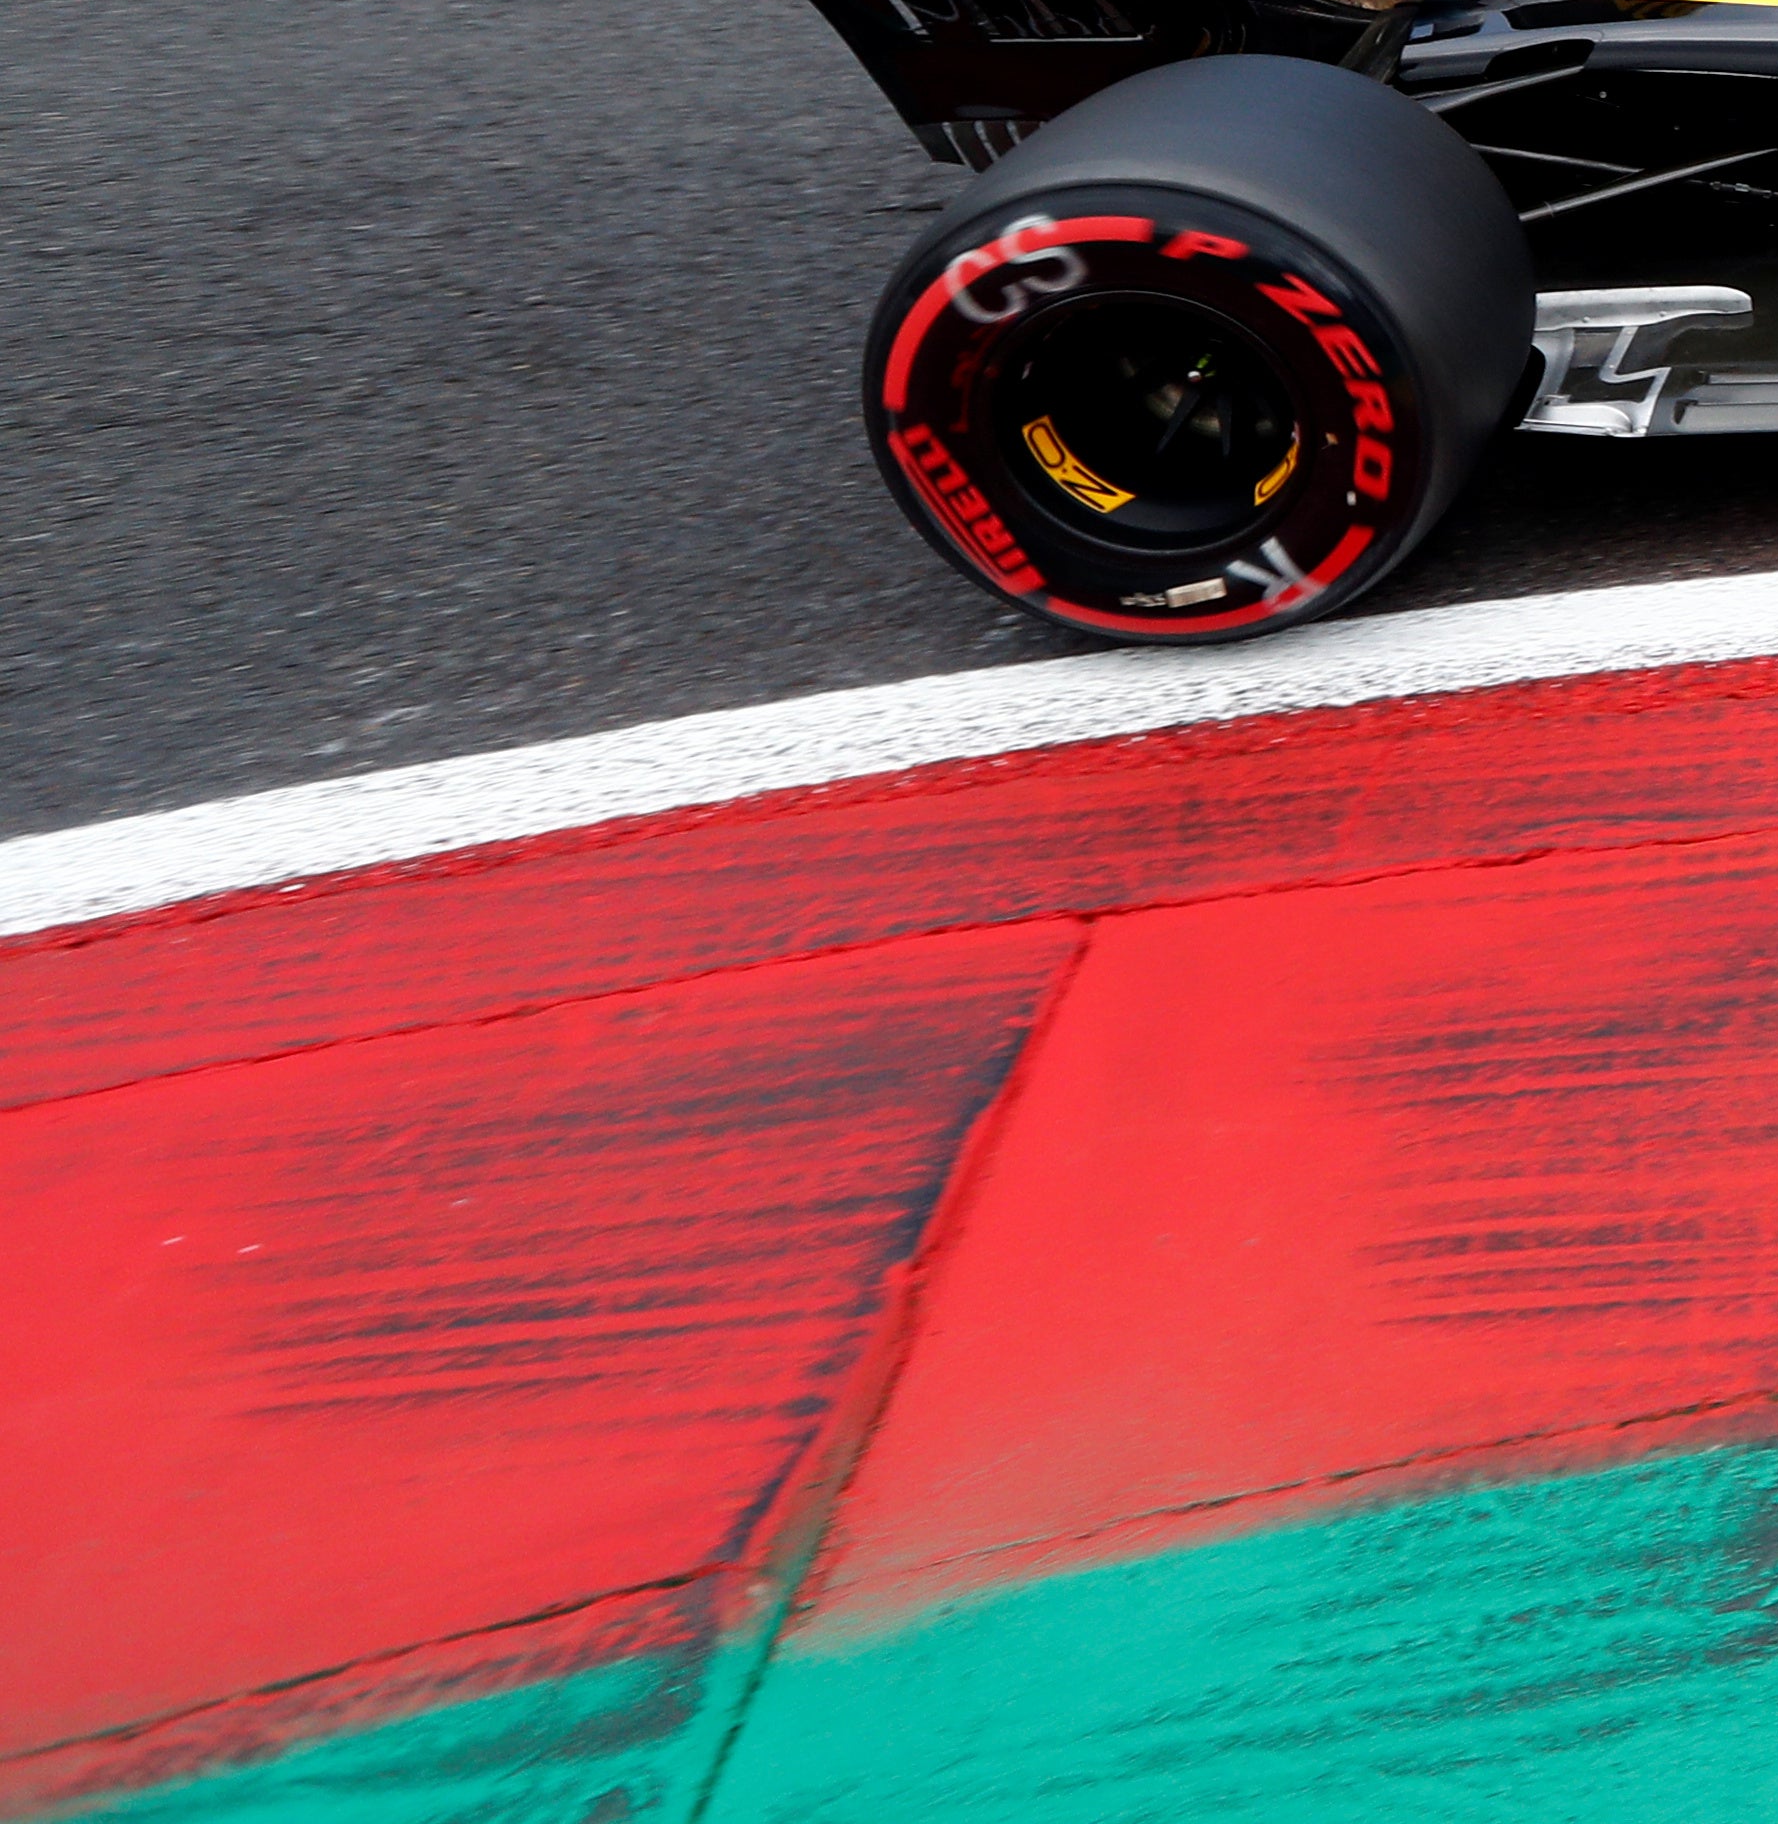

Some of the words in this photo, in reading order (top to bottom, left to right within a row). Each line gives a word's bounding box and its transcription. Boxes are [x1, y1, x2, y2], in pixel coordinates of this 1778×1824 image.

[1160, 231, 1252, 259] P
[1256, 273, 1393, 501] ZERO
[888, 423, 1046, 594] PIRELLI
